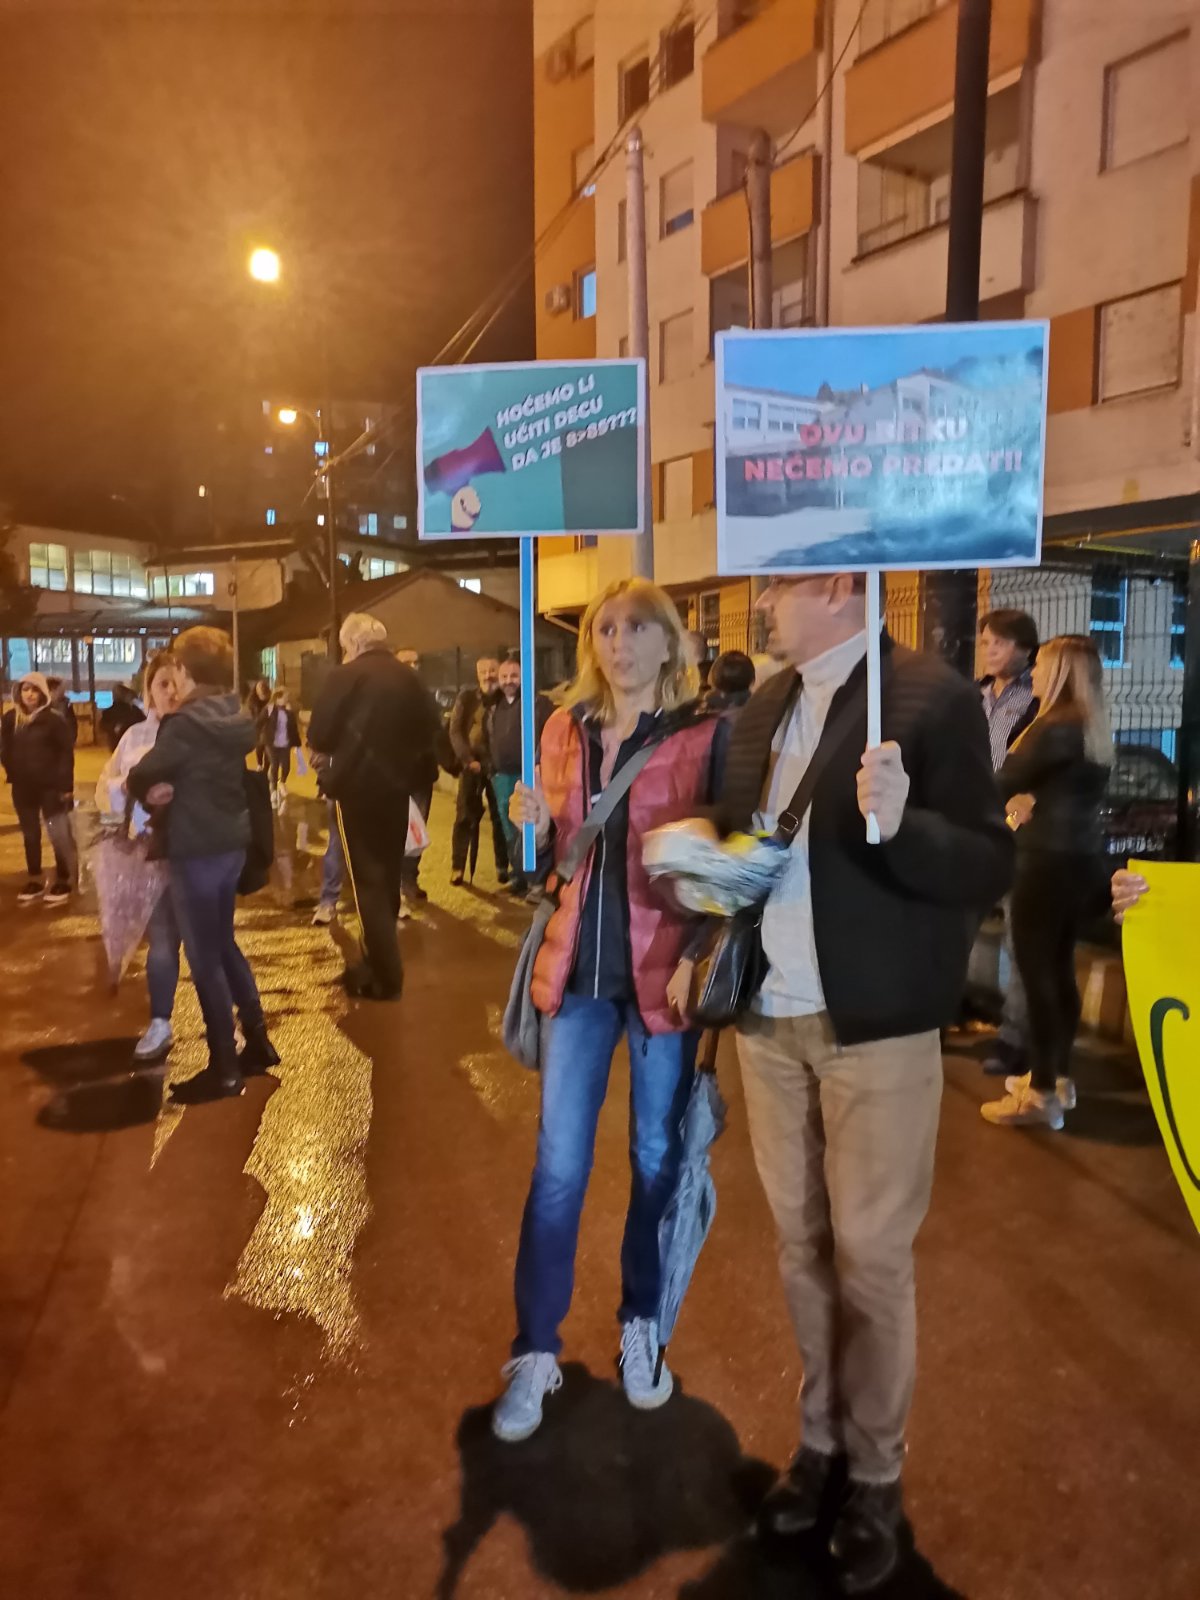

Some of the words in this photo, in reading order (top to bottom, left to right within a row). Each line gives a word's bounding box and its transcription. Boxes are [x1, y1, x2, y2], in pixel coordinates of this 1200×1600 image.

[578, 374, 595, 394] LI
[554, 395, 603, 429] DECU
[800, 423, 864, 446] OVU
[512, 448, 538, 471] DA
[542, 436, 562, 459] JE
